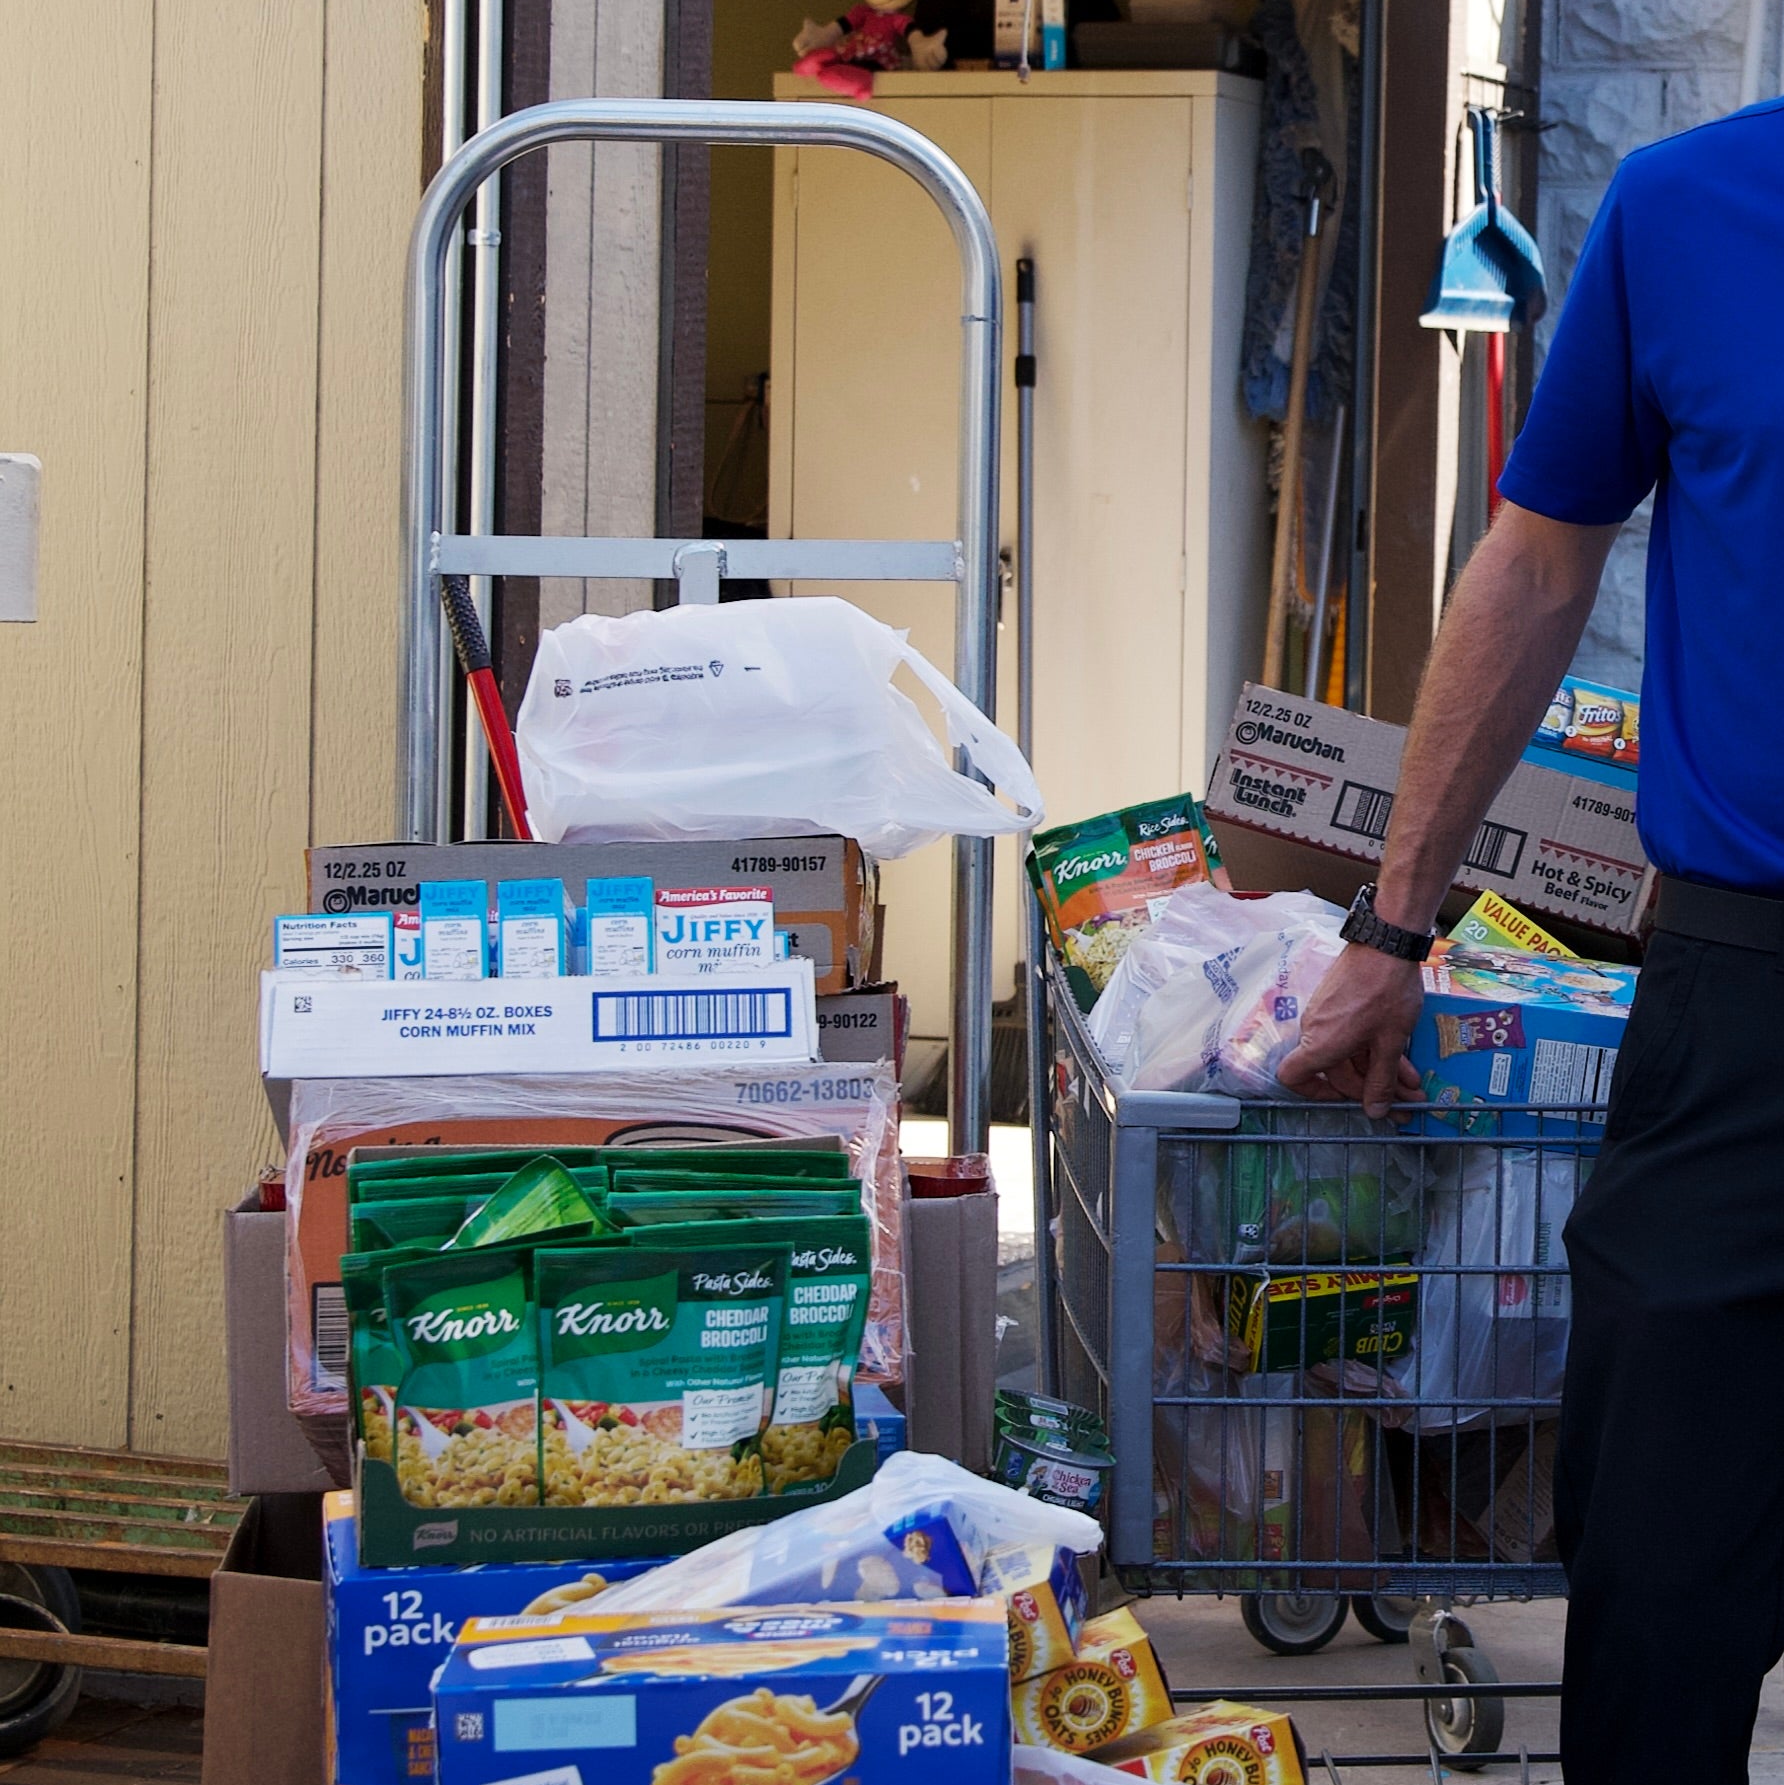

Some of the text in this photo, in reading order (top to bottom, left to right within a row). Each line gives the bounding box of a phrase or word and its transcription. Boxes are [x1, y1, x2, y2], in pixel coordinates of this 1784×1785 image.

[1246, 699, 1312, 728] 12/2.25 OZ
[1580, 704, 1622, 725] Fritos
[1257, 722, 1345, 763] Maruchan
[1230, 768, 1308, 806] Instant
[1139, 814, 1189, 837] Rice Sides
[731, 855, 827, 874] 41789-90157
[1134, 842, 1176, 863] CHICKEN
[1148, 850, 1197, 873] BROCCOLI
[323, 860, 407, 880] 12/2.25 OZ
[1053, 851, 1128, 885] Knorr
[1531, 860, 1632, 904] Hot & Spicy
[659, 887, 768, 903] America's Favorite
[1543, 882, 1609, 911] Beef Flavor
[282, 921, 358, 931] Nutrition Facts
[660, 915, 766, 944] JIFFY
[1463, 919, 1489, 940] 20
[1481, 897, 1531, 940] VALUE
[282, 953, 385, 966] Calories 330 360
[666, 943, 762, 960] corn muffin
[381, 1008, 421, 1022] JIFFY
[475, 1006, 500, 1019] OZ.
[504, 1005, 553, 1018] BOXES
[399, 1022, 536, 1039] CORN MUFFIN MIX
[620, 1043, 626, 1052] 2
[661, 1041, 701, 1050] 72486
[710, 1040, 750, 1049] 00220
[759, 1039, 766, 1049] 9
[734, 1077, 875, 1104] 70662-13803
[816, 1246, 857, 1272] Sides
[692, 1270, 773, 1295] Pasta Sides
[793, 1283, 858, 1305] CHEDDAR
[407, 1308, 520, 1343] Knorr
[555, 1302, 670, 1335] Knorr
[705, 1306, 769, 1328] CHEDDAR
[788, 1303, 854, 1326] BROCCOLI
[700, 1324, 768, 1348] BROCCOLI
[687, 1376, 711, 1387] Other
[713, 1374, 744, 1386] Natural
[782, 1371, 806, 1384] Our
[692, 1394, 713, 1407] Our
[469, 1520, 711, 1543] NO ARTIFICIAL FLAVORS OR
[383, 1590, 424, 1620] 12
[1013, 1591, 1039, 1622] Post
[364, 1612, 456, 1656] pack
[1110, 1648, 1134, 1678] Post
[1065, 1669, 1117, 1695] HONEY
[915, 1691, 955, 1721] 12
[1085, 1687, 1125, 1747] BUNCHES
[899, 1714, 984, 1756] pack
[1044, 1705, 1078, 1746] OATS
[1204, 1740, 1255, 1763] HONEY
[1251, 1725, 1276, 1755] Post
